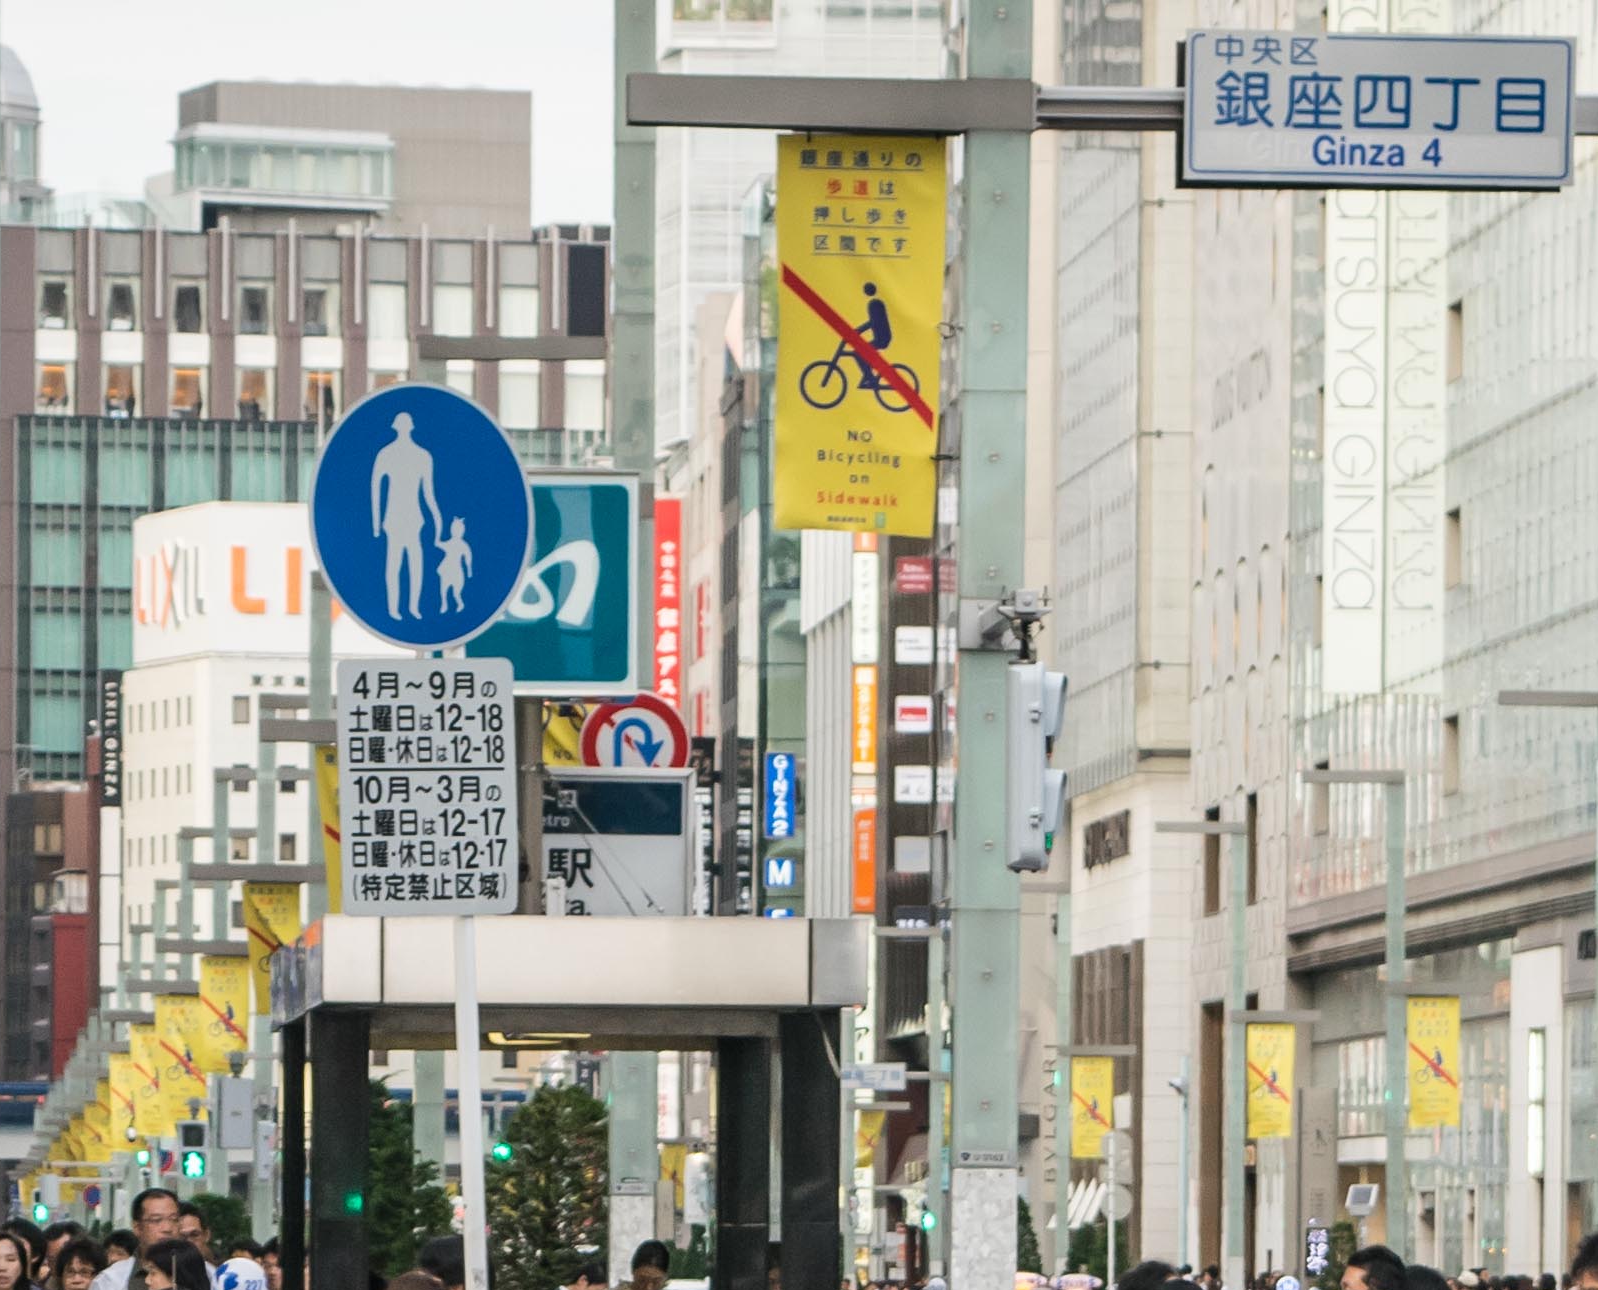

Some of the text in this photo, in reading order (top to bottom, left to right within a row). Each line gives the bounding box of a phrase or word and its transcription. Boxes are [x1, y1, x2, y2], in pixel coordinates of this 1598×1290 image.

[1214, 34, 1318, 66] 中央区
[1214, 70, 1546, 133] 銀座四丁目
[1313, 135, 1443, 167] Ginza 4
[827, 178, 894, 195] 歩道は
[814, 235, 906, 252] 区間です
[847, 430, 872, 442] NO
[817, 450, 900, 468] Bicycling
[850, 474, 869, 483] on
[817, 491, 897, 506] Sidewalk
[136, 541, 205, 631] LIXIL
[348, 704, 503, 732] 土曜日は12-18
[105, 738, 118, 796] GINZA
[352, 808, 505, 836] 土曜日は12-17
[768, 859, 792, 886] M
[353, 873, 507, 901] (特定禁止区域)
